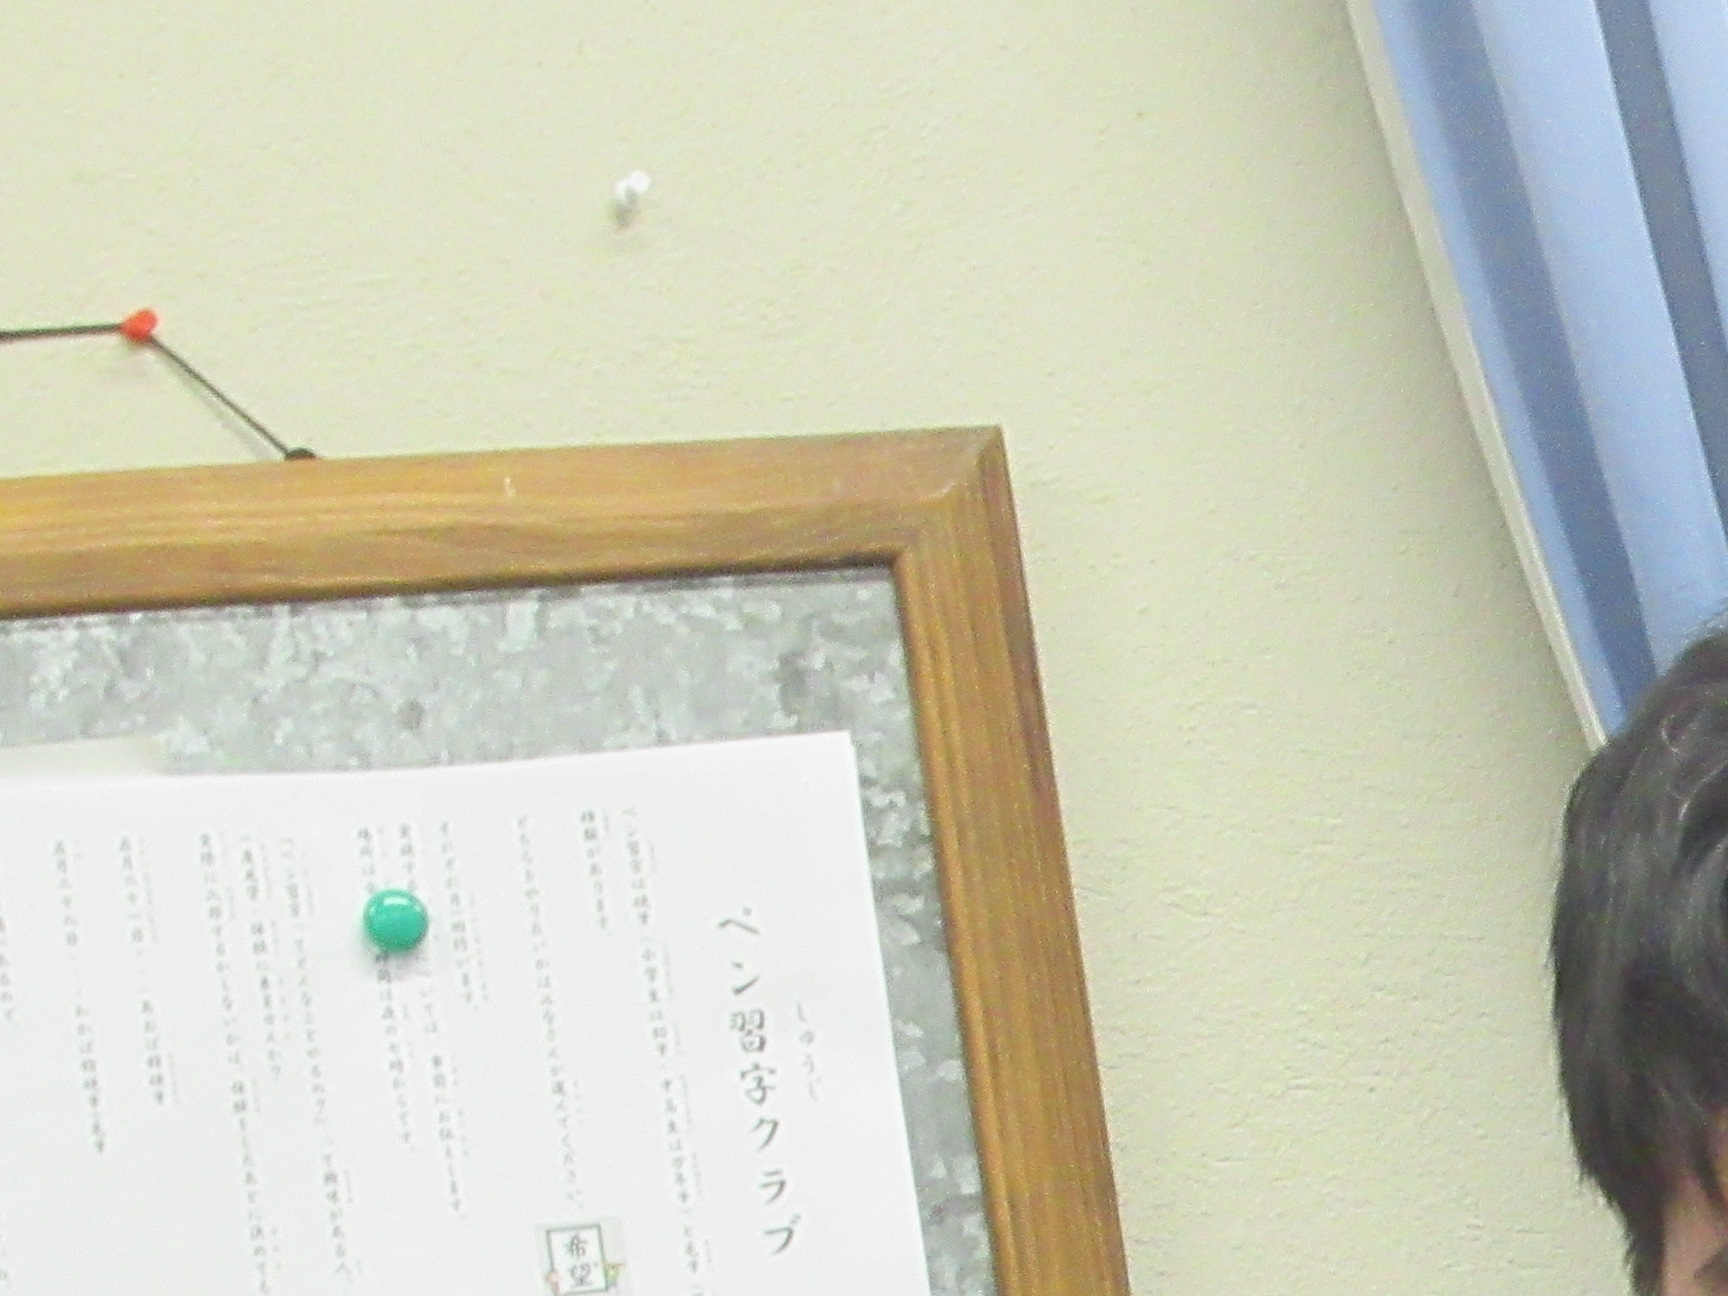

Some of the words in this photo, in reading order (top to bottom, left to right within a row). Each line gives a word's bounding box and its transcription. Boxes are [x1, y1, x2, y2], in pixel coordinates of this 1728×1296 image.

[714, 905, 802, 1256] ペン習字クラブ
[795, 1000, 822, 1102] しゅうじ
[564, 1233, 598, 1288] 希望
